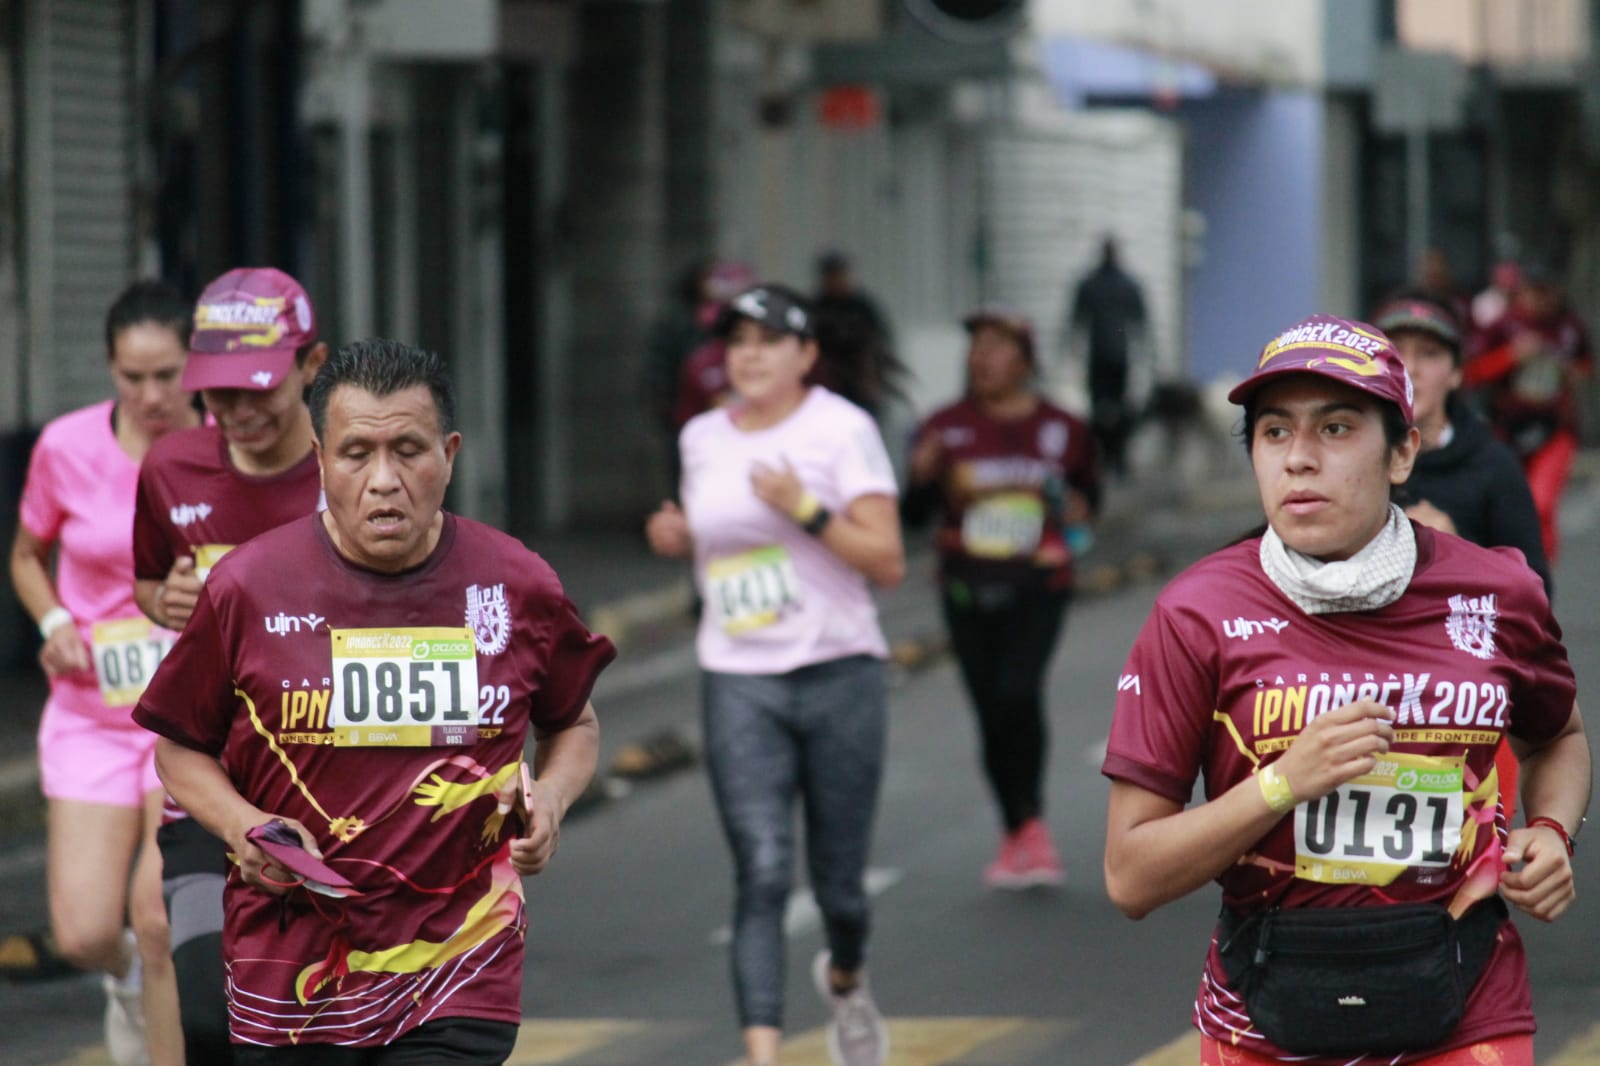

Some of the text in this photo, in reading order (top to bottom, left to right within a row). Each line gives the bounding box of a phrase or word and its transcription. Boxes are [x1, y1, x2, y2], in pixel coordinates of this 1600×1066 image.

[103, 641, 166, 690] 087
[342, 661, 469, 723] 0851
[1255, 672, 1398, 689] CARRERA
[281, 689, 335, 729] IPN
[368, 732, 398, 742] BBVA
[1425, 731, 1497, 744] FRONTERAS
[1305, 788, 1452, 863] 0131
[1332, 869, 1367, 881] BBVA
